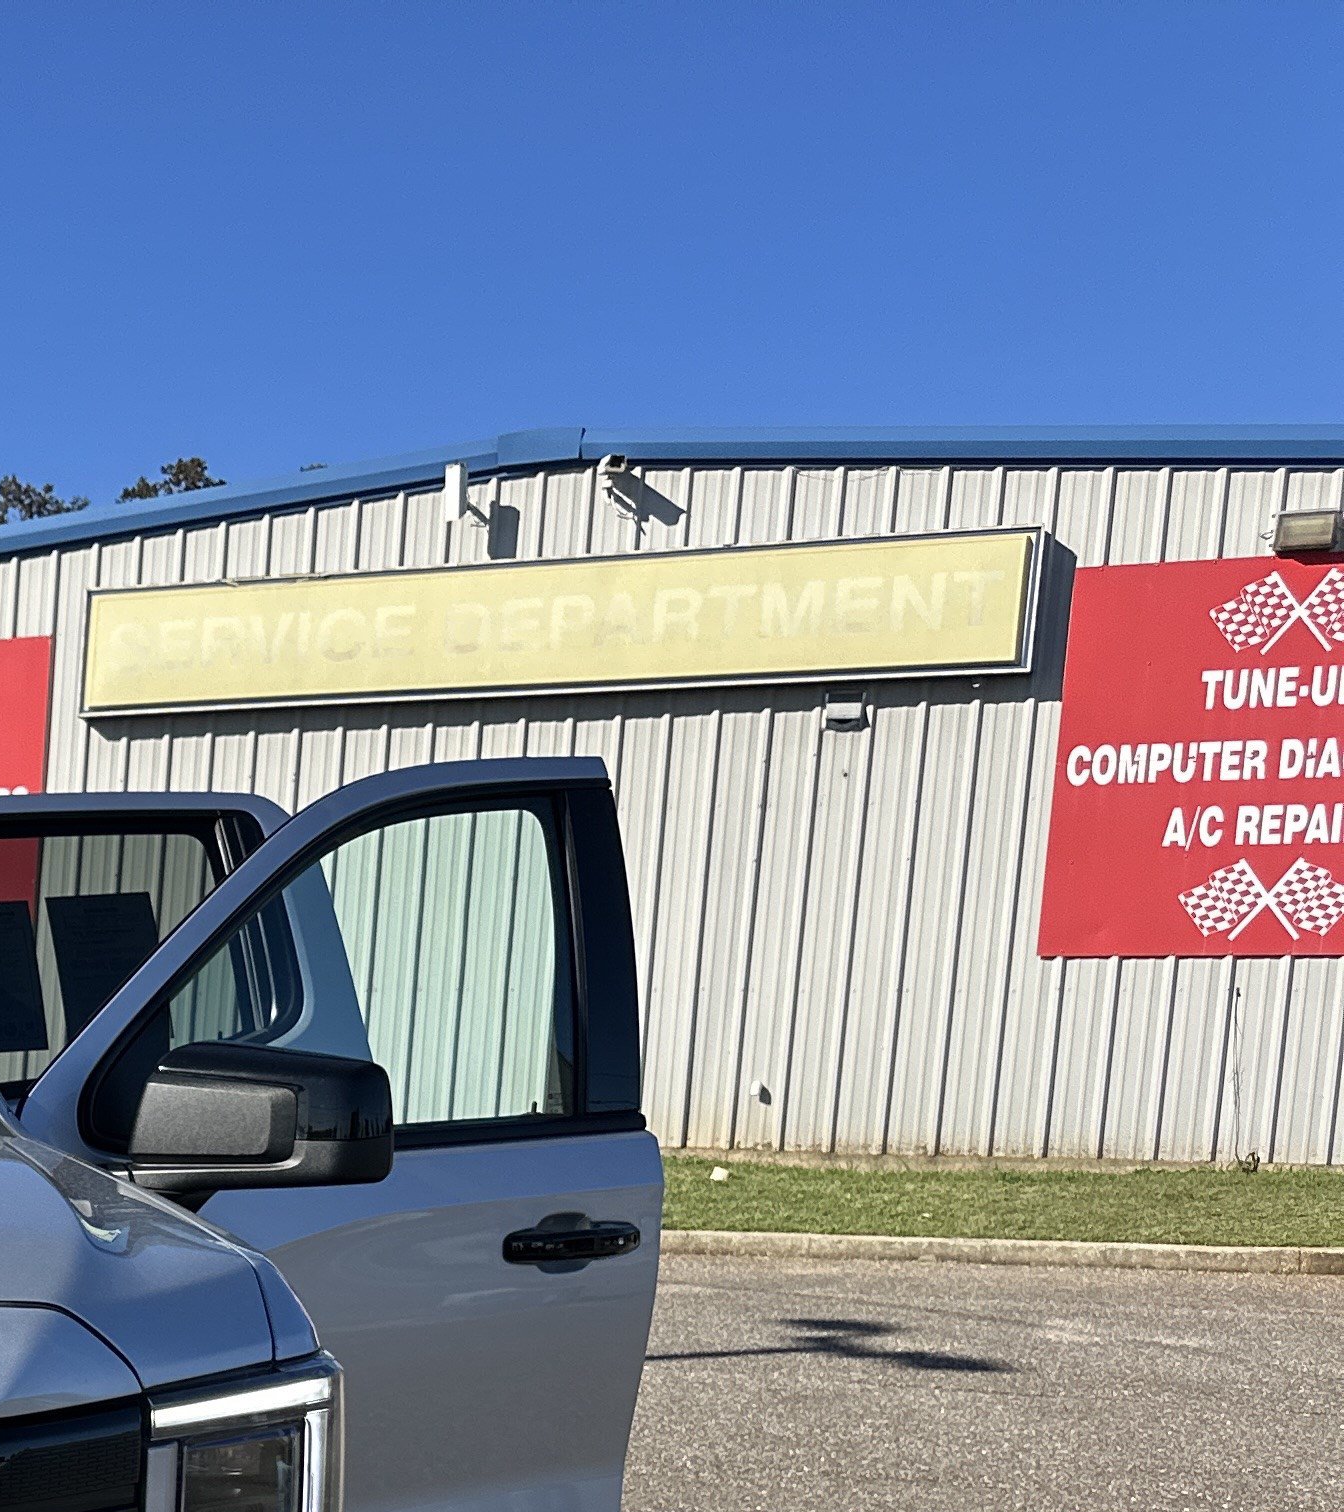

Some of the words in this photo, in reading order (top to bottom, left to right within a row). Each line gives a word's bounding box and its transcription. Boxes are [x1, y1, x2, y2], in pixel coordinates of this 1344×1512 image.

[109, 603, 417, 674] SERVICE
[443, 568, 1005, 653] DEPARTMENT
[1066, 739, 1269, 787] COMPUTER
[1278, 736, 1344, 780] DIA
[1161, 804, 1225, 852] A/C
[1234, 802, 1344, 846] REPAI
